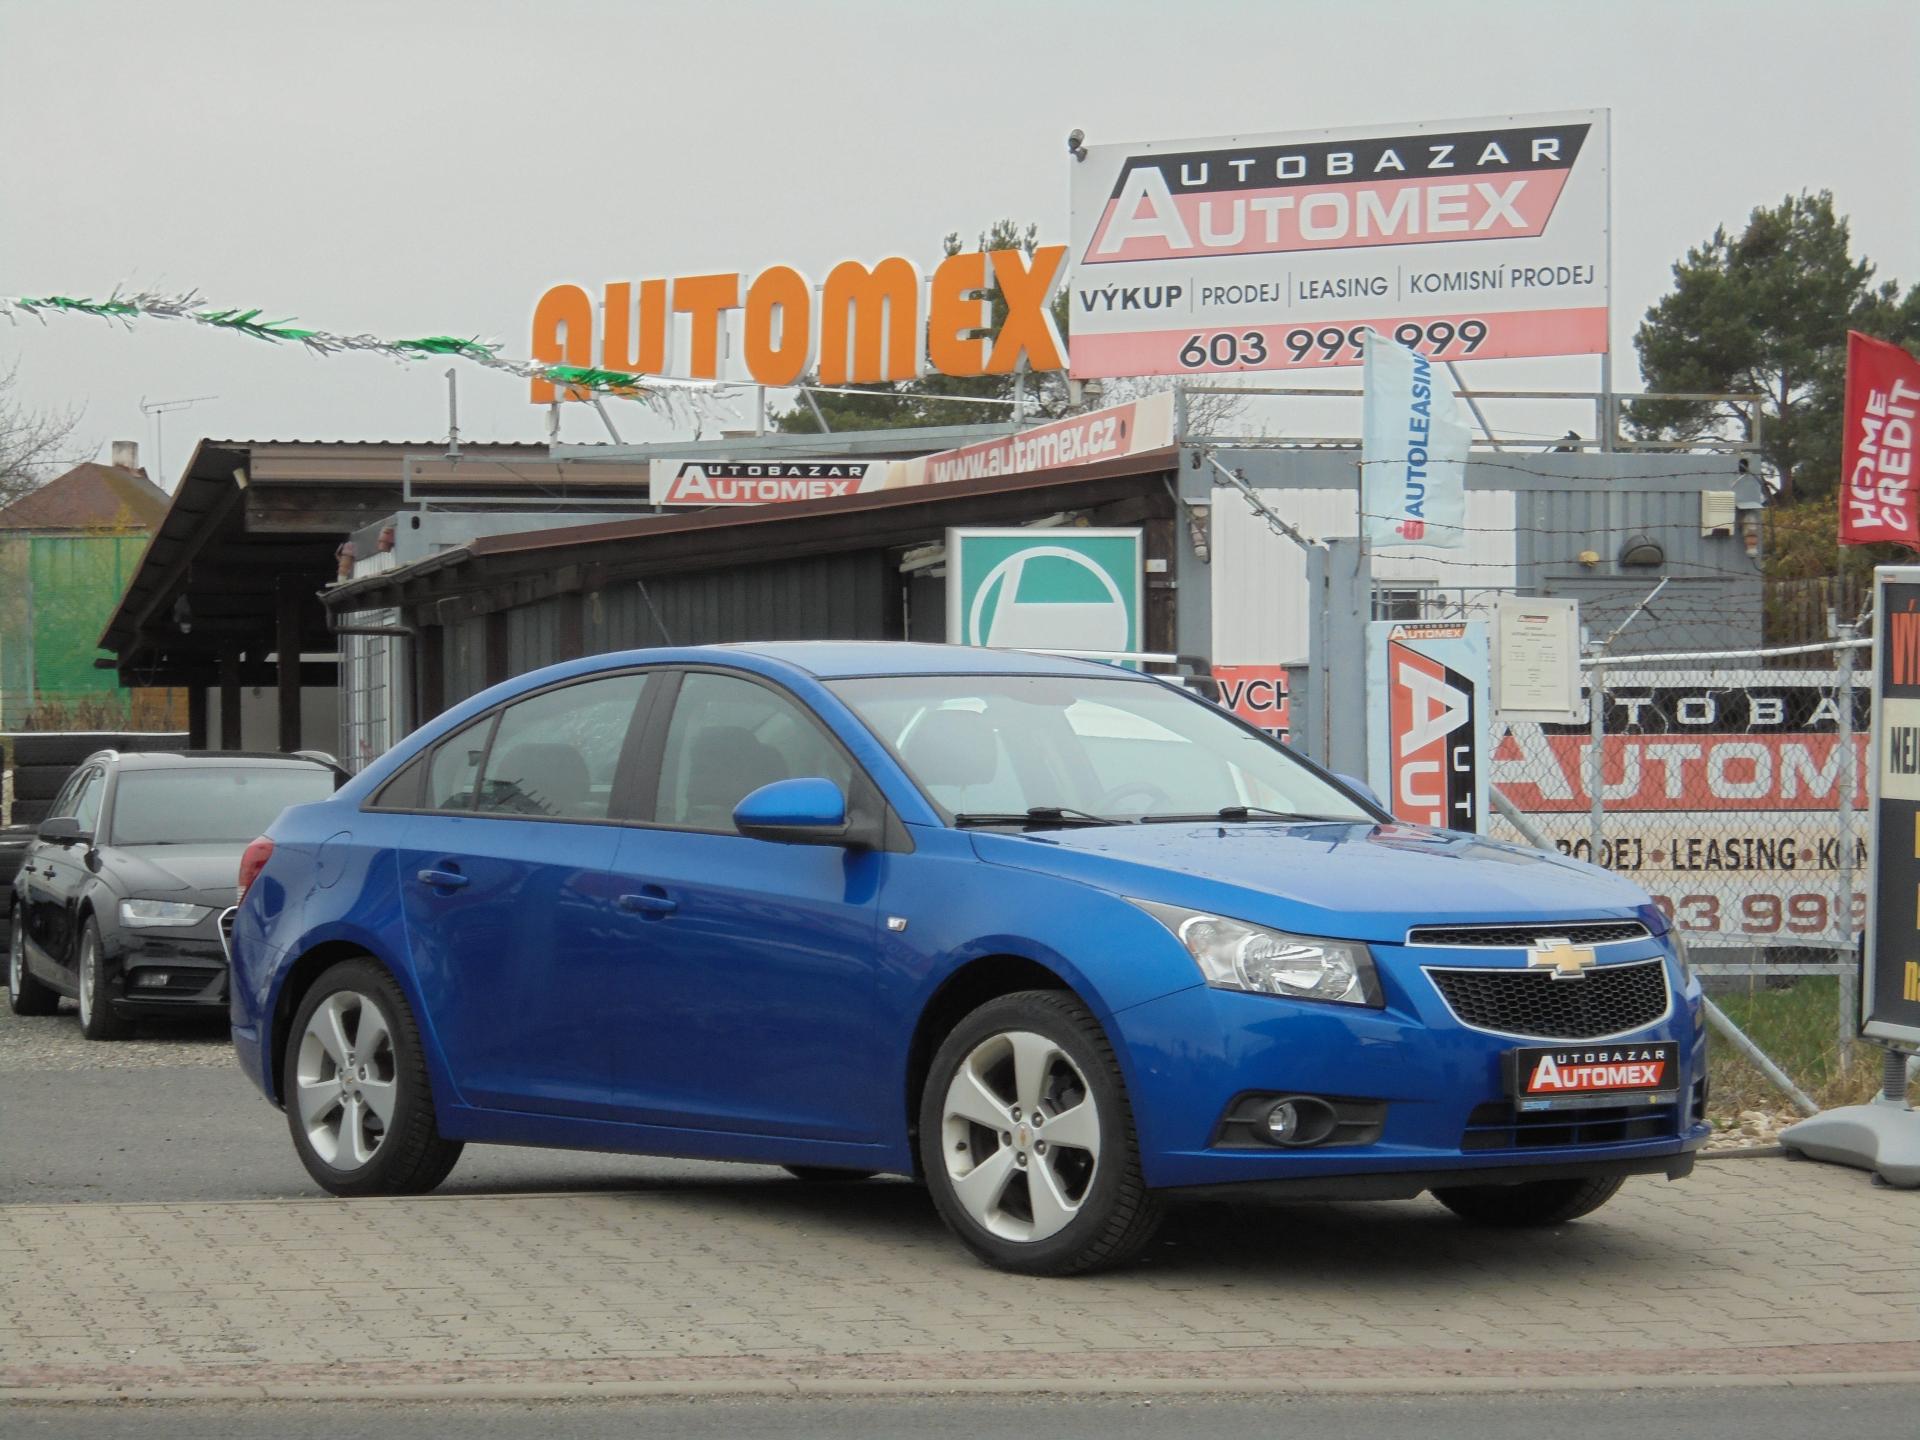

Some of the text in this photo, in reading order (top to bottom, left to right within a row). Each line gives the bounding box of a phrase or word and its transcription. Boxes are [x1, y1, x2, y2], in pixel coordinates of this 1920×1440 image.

[1096, 166, 1529, 254] AUTOMEX
[1080, 264, 1594, 312] VÝKUP PRODEJ LEASING KOMISNÍ PRODEJ
[530, 245, 1069, 404] AUTOMEX
[1179, 331, 1268, 369] 603
[1393, 320, 1488, 355] 999
[933, 416, 1117, 484] www.automex.cz
[1405, 352, 1431, 518] AUTOLEASIN
[1849, 388, 1887, 528] HOME
[1877, 378, 1920, 532] CREDIT
[673, 466, 848, 499] AUTOMEX
[1672, 837, 1796, 871] LEASING
[1532, 1055, 1657, 1089] AUTOMEX
